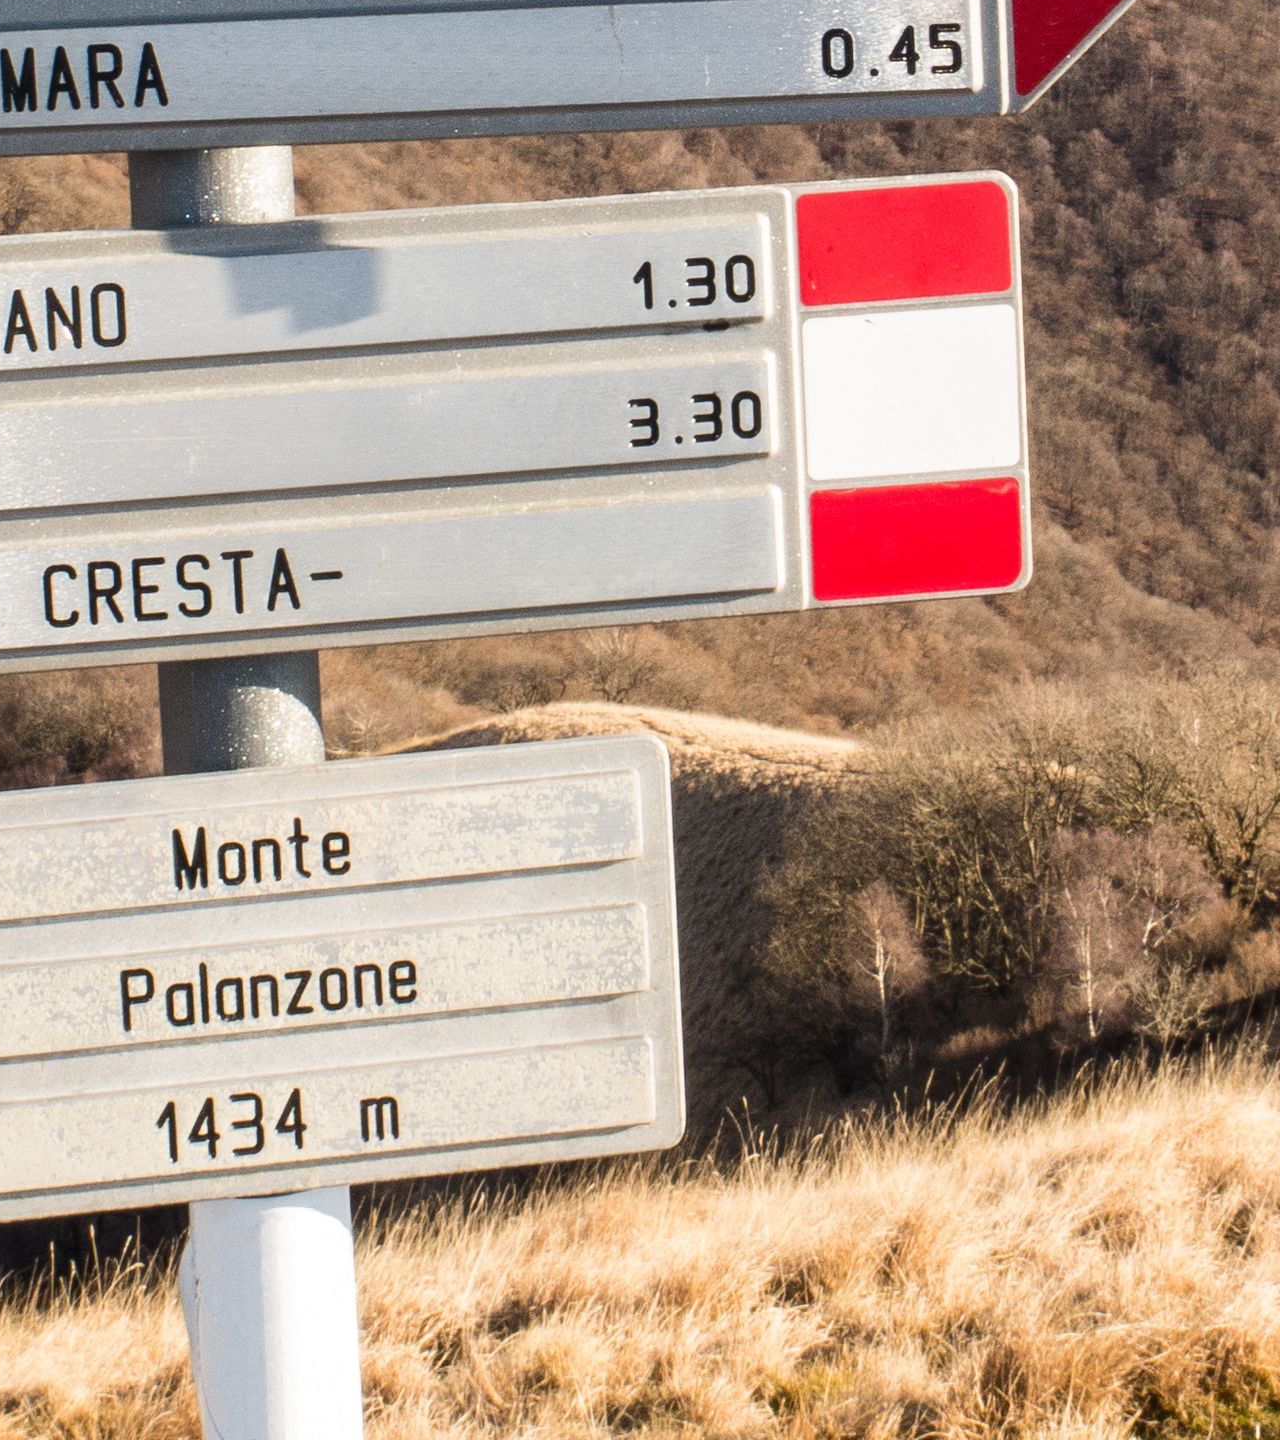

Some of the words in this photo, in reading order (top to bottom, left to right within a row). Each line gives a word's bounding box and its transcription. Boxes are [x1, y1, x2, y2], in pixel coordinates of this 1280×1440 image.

[0, 42, 169, 113] MARA
[821, 23, 962, 79] 0.45
[633, 254, 756, 310] 1.30
[628, 390, 762, 447] 3.30
[172, 818, 351, 890] Monte
[120, 960, 417, 1031] Palanzone
[157, 1088, 307, 1163] 1434
[361, 1097, 399, 1142] m
